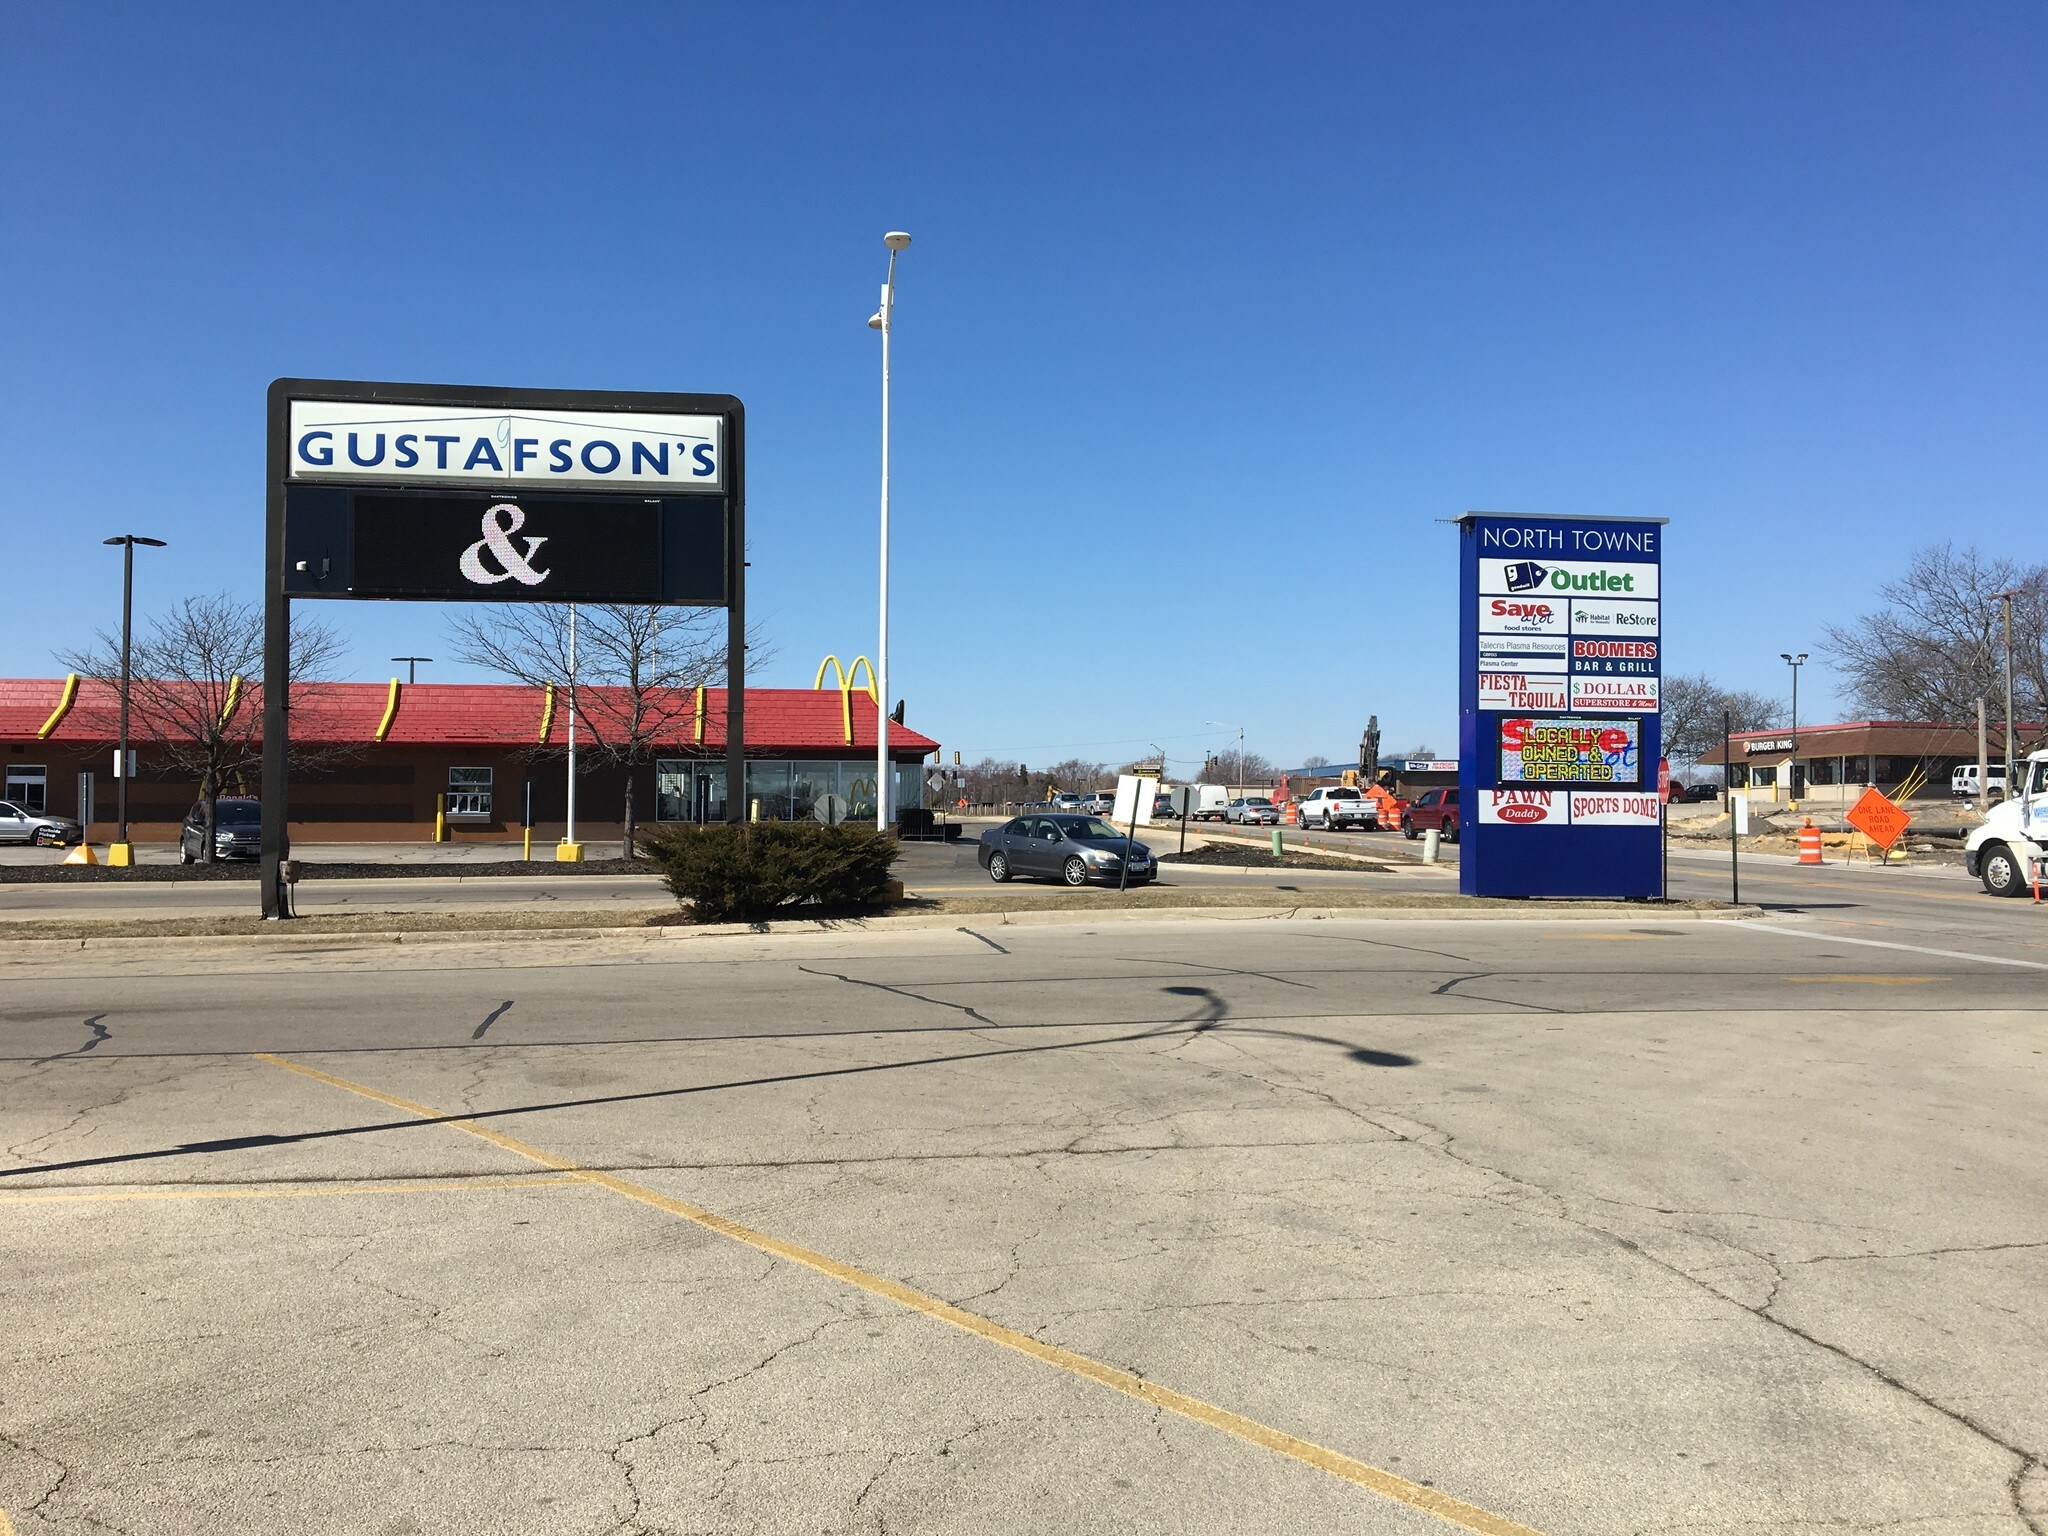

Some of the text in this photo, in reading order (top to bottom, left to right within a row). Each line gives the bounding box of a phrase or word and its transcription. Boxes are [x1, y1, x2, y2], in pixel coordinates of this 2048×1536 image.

[297, 430, 717, 477] GUSTAFSON'S
[459, 503, 550, 586] &
[1484, 527, 1654, 552] NORTH TOWNE
[1551, 569, 1634, 592] Outlet
[1491, 599, 1551, 617] Save
[1590, 613, 1611, 621] Habitat
[1616, 613, 1657, 626] ReStore
[1480, 641, 1566, 651] Talecris Plasma Resources
[1574, 640, 1657, 659] BOOMERS
[1575, 661, 1655, 673] BAR & GRILL
[1480, 674, 1527, 691] FIESTA
[1583, 682, 1647, 696] DOLLAR
[1508, 691, 1567, 710] TEQUILA
[1574, 698, 1631, 707] SUPERSTORE
[1523, 727, 1603, 744] LOCALLY
[1521, 745, 1603, 762] OWNED &
[1751, 740, 1792, 751] BURGER KING
[1523, 763, 1613, 780] OPERATED
[1658, 770, 1669, 788] STOP
[1491, 790, 1553, 807] PAWN
[1505, 808, 1540, 819] Daddy
[1573, 797, 1658, 819] SPORTS DOME
[1858, 806, 1896, 814] ONE LANE
[1868, 815, 1890, 823] ROAD
[1869, 825, 1895, 833] AHEAD
